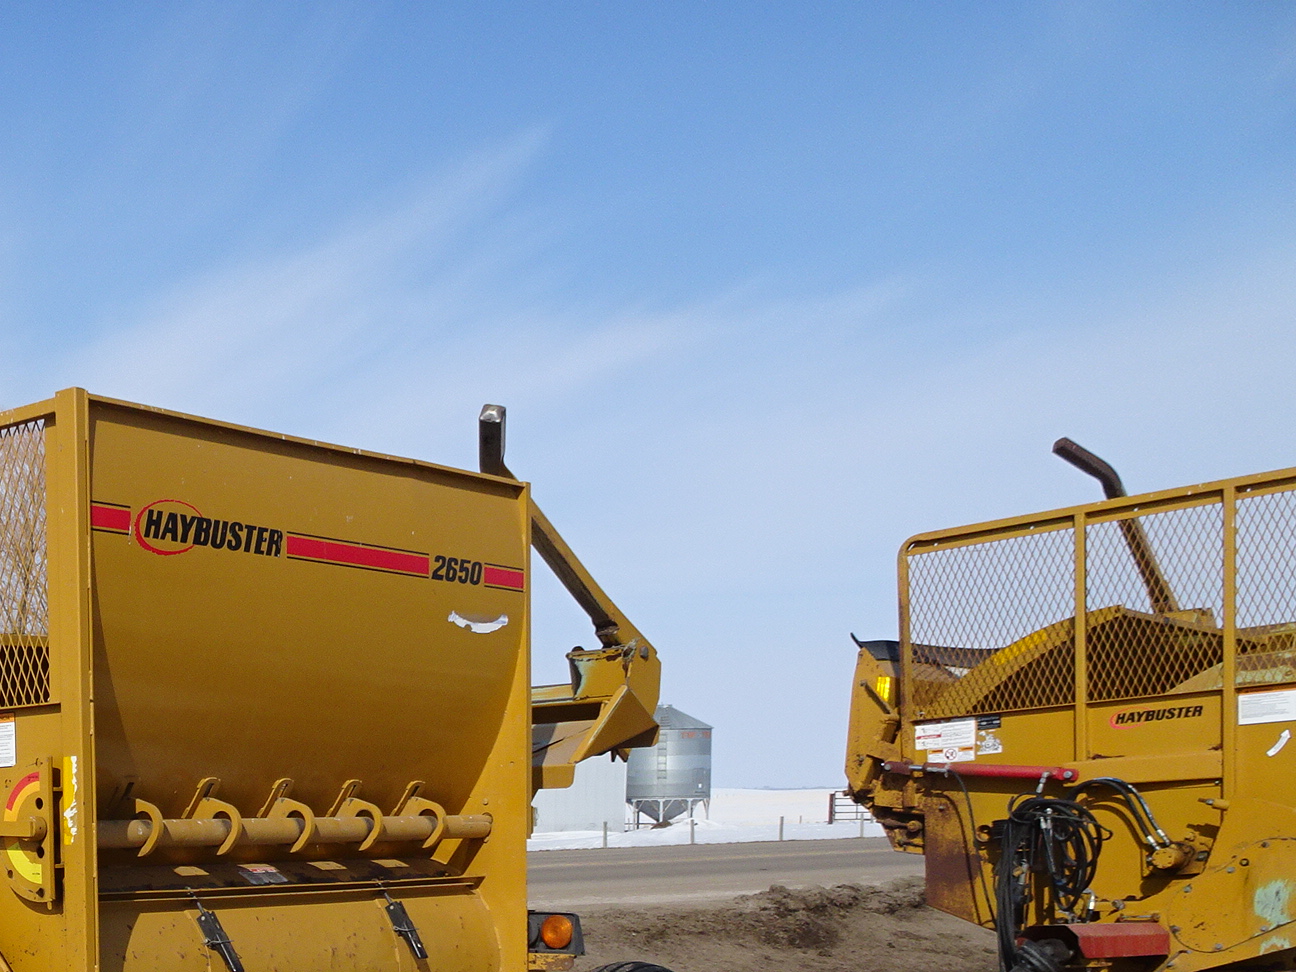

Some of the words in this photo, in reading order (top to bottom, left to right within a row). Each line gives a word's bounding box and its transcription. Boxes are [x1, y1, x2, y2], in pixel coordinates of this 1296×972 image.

[144, 509, 284, 557] HAYBUSTER
[431, 555, 483, 586] 2650
[1115, 705, 1204, 725] HAYBUSTER
